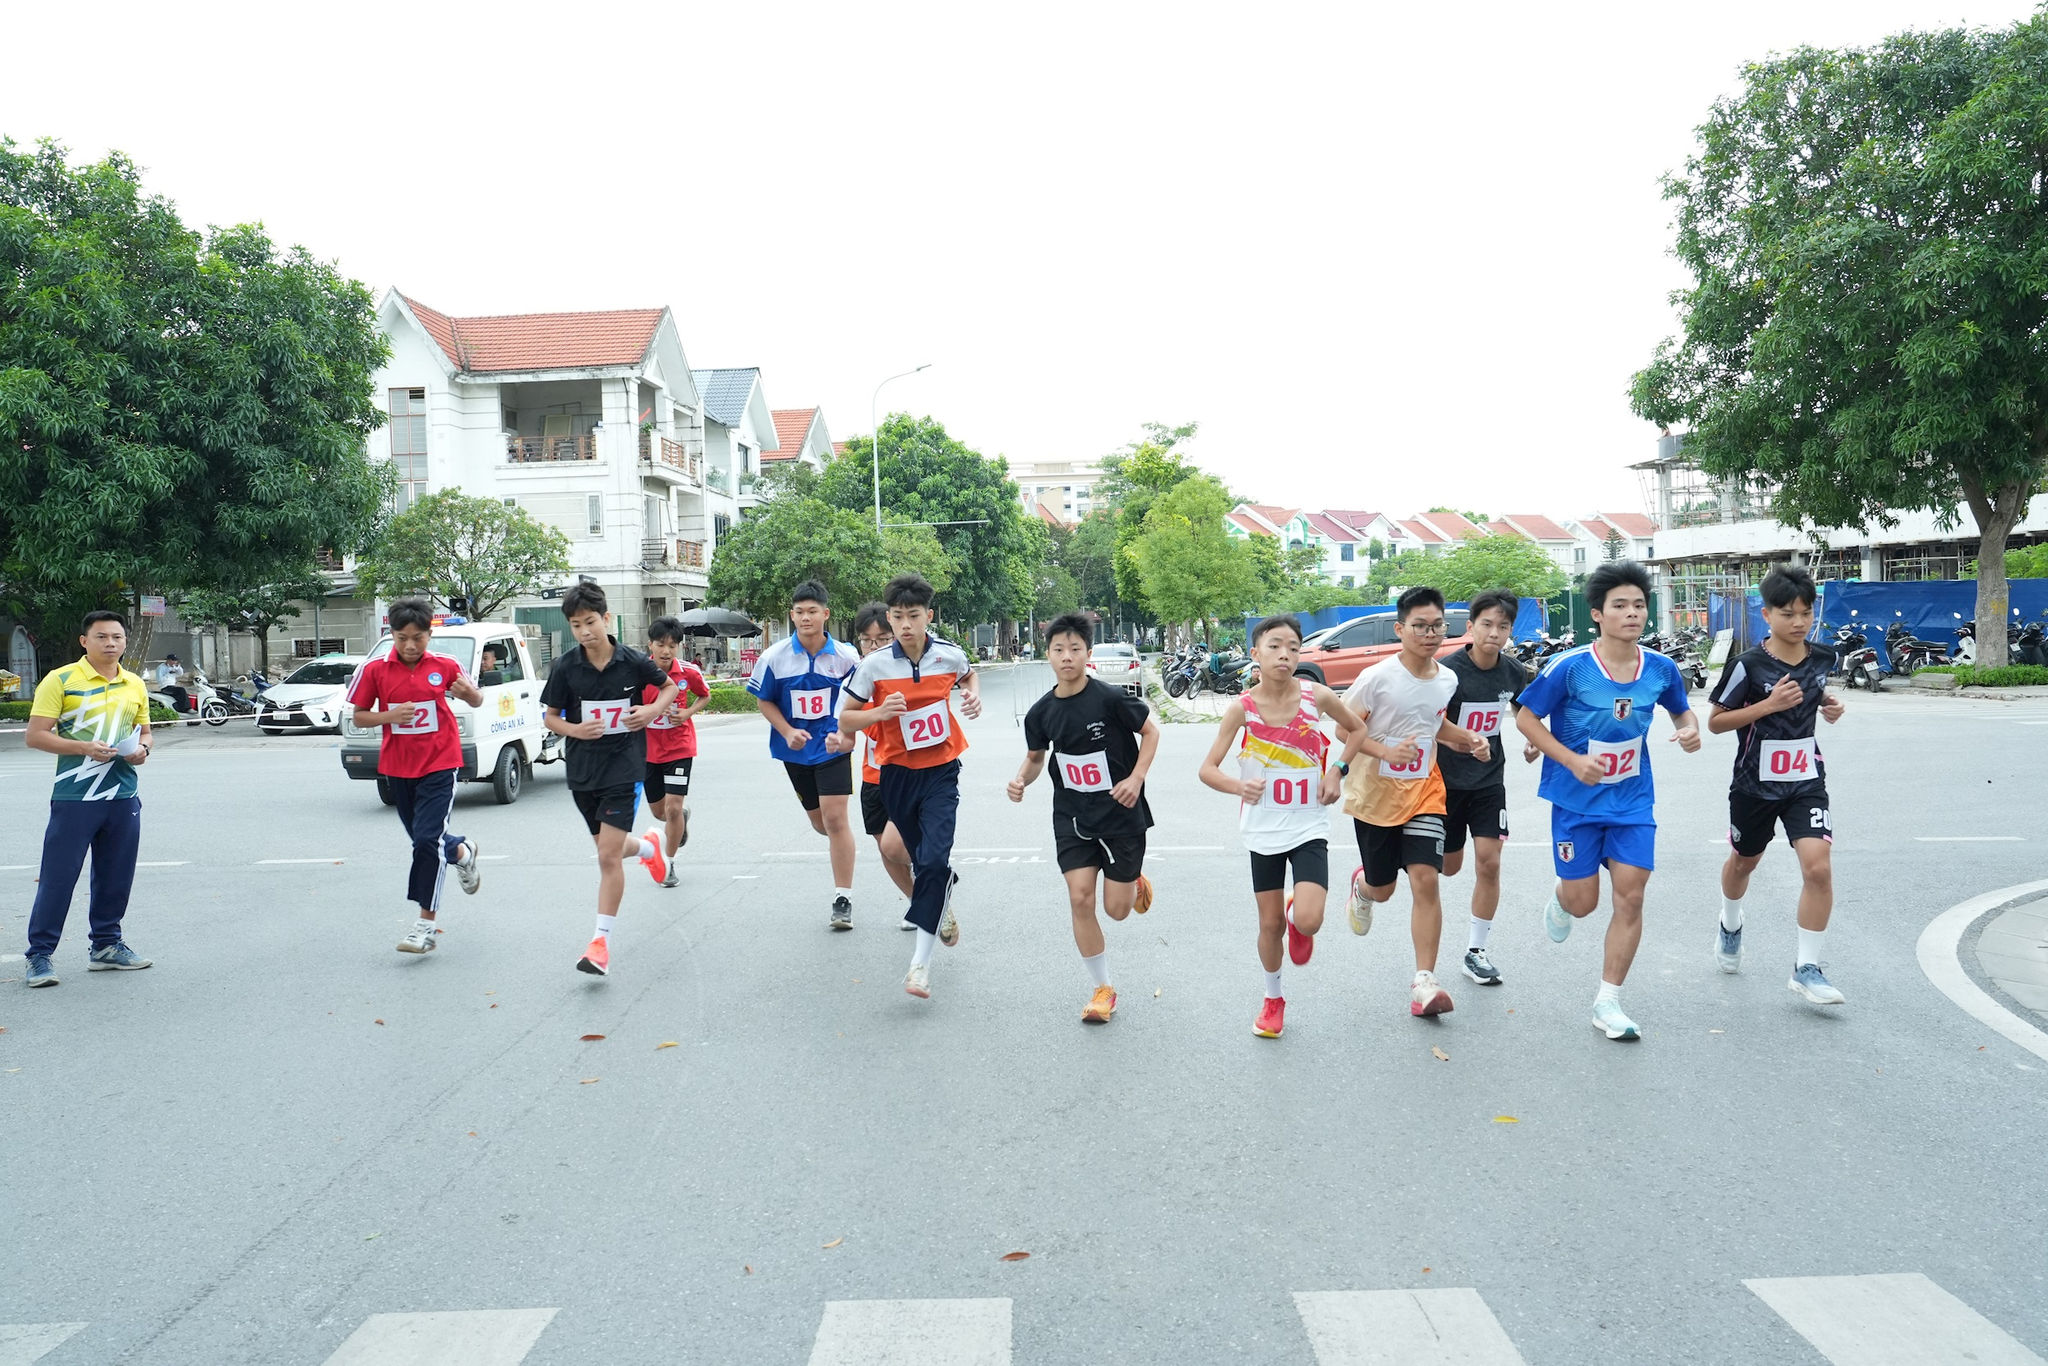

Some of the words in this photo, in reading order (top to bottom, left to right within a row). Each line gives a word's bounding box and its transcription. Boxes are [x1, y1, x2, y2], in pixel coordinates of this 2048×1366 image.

[797, 696, 823, 714] 18
[399, 708, 431, 729] 2
[508, 719, 516, 728] AN
[909, 712, 944, 743] 20
[1466, 711, 1499, 732] 05
[1597, 749, 1635, 777] 02
[1769, 749, 1808, 775] 04
[1066, 763, 1102, 786] 06
[1273, 778, 1308, 805] 01
[1809, 807, 1831, 831] 20
[949, 856, 1048, 865] THC
